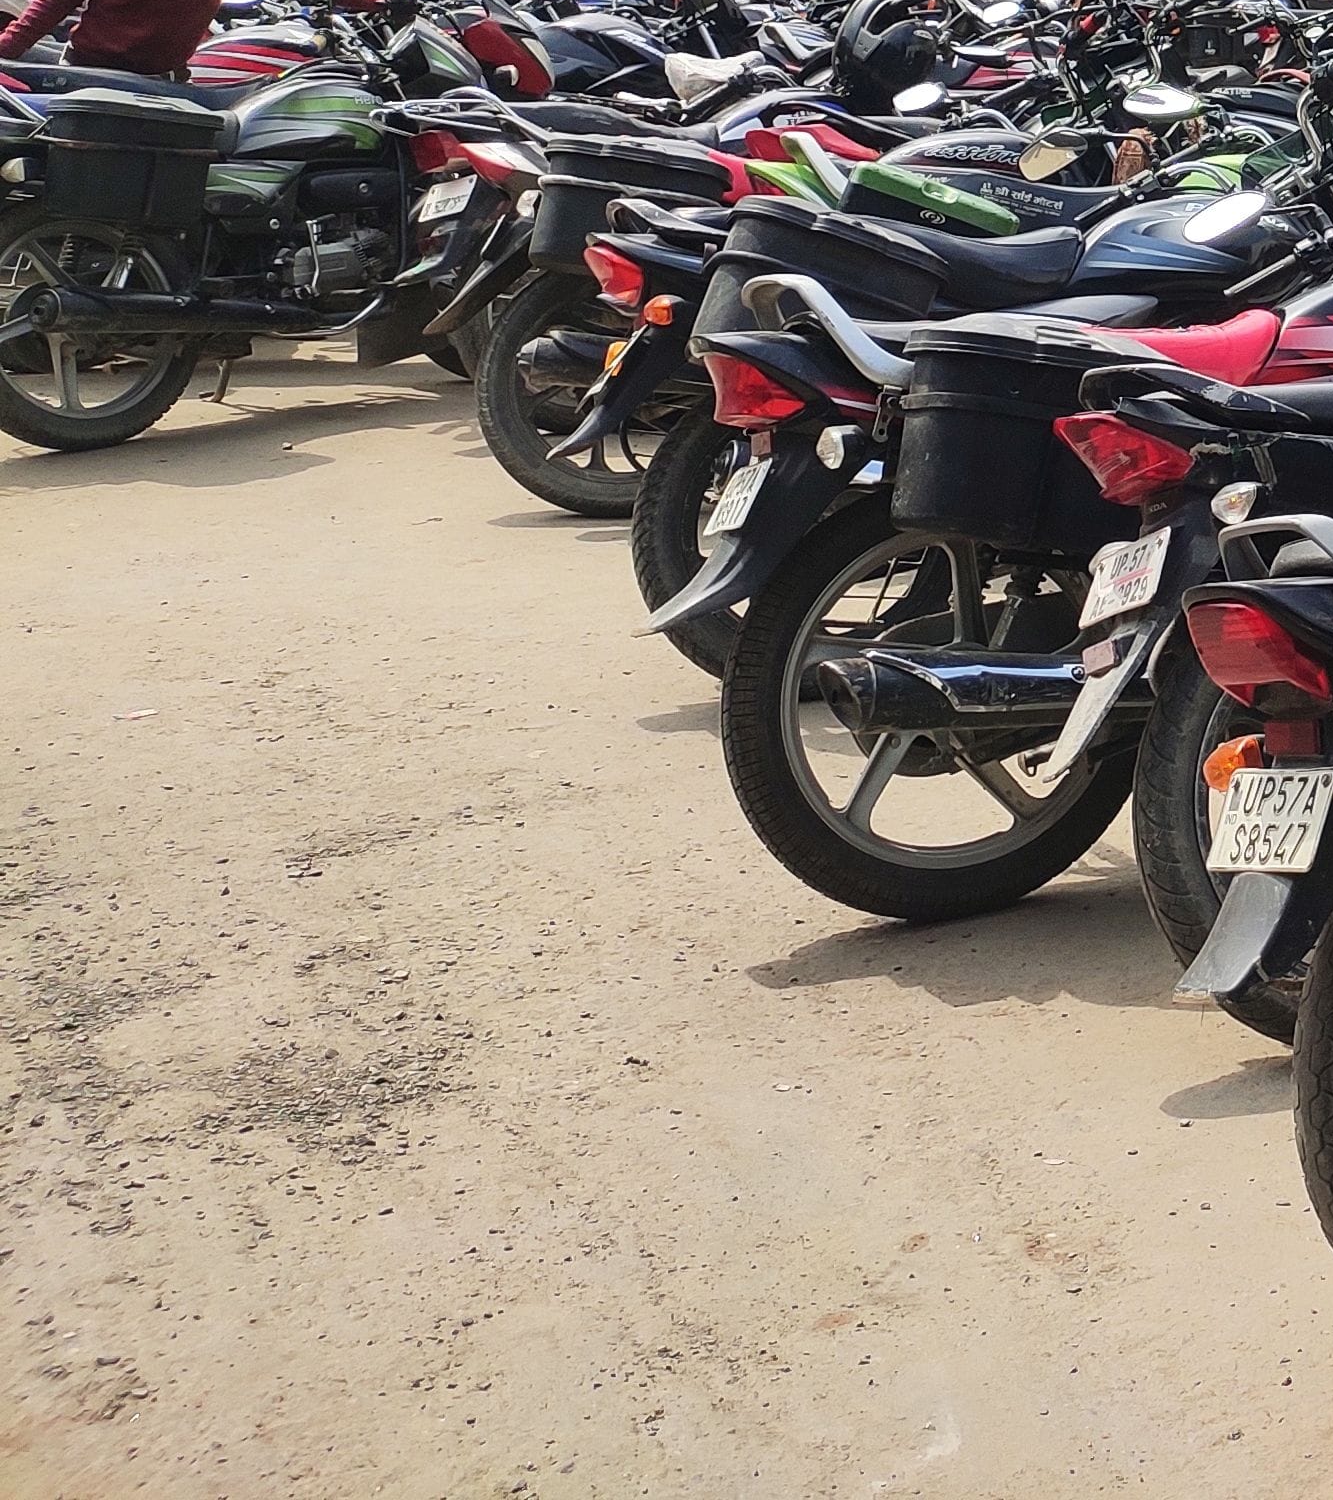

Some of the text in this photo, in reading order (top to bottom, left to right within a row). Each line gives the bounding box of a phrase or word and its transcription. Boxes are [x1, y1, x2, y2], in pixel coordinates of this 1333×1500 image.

[354, 94, 383, 105] Hero
[1243, 775, 1320, 816] UP57A
[1229, 823, 1309, 865] S8547
